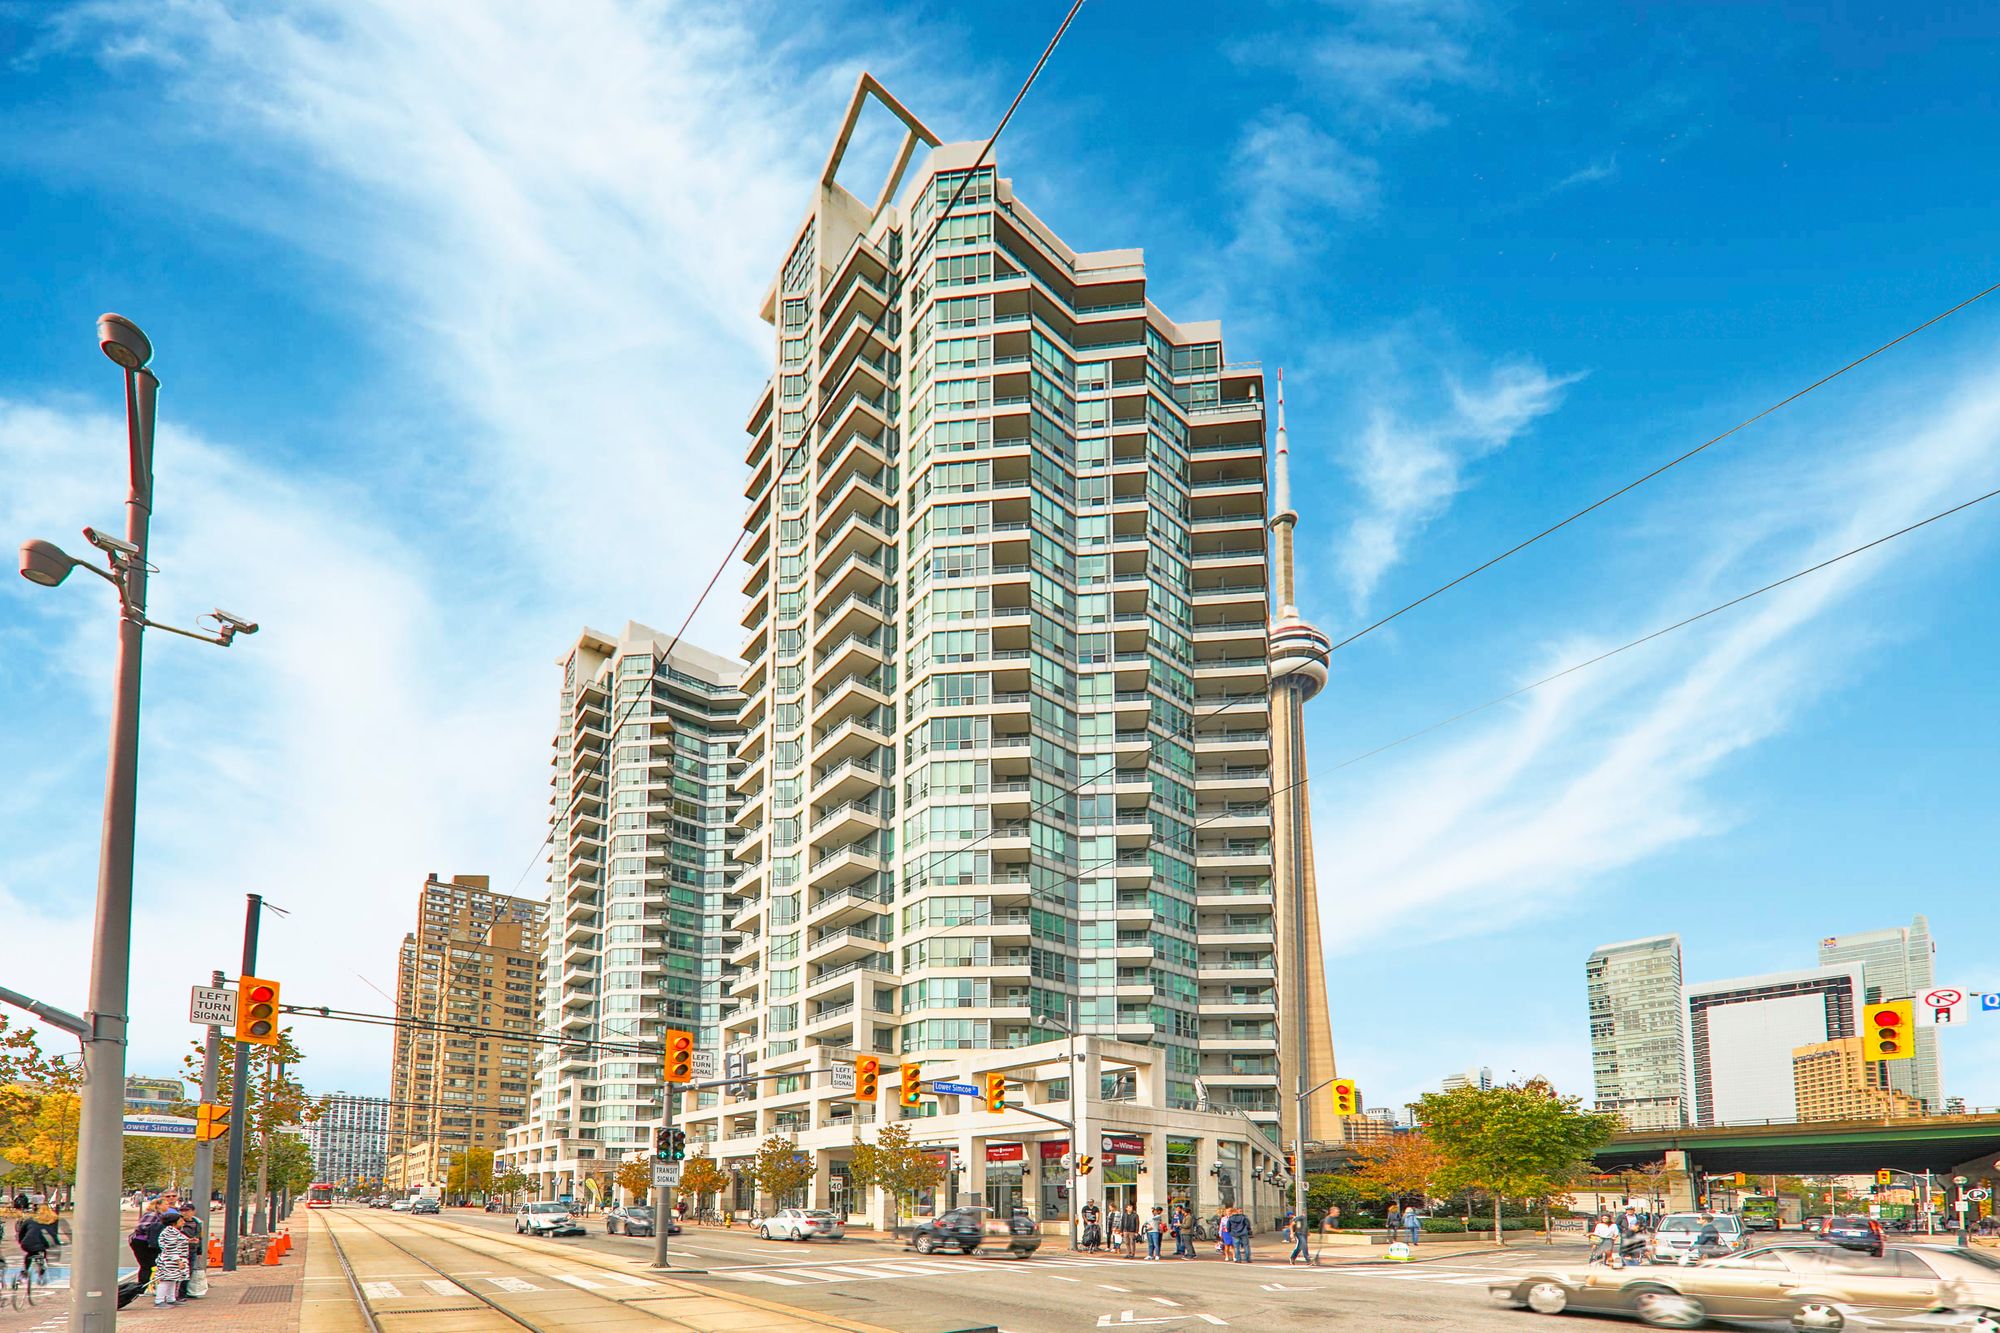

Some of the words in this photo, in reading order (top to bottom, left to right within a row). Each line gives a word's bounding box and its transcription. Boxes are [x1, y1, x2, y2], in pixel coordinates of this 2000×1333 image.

[199, 991, 230, 1001] LEFT
[197, 1001, 231, 1011] TURN
[193, 1011, 233, 1022] SIGNAL
[935, 1082, 951, 1091] Lower
[952, 1084, 972, 1094] Simcoe
[152, 1124, 185, 1132] Simcoe
[1119, 1141, 1134, 1149] Wine
[656, 1166, 678, 1174] TRANSIT
[657, 1175, 676, 1183] SIGNAL
